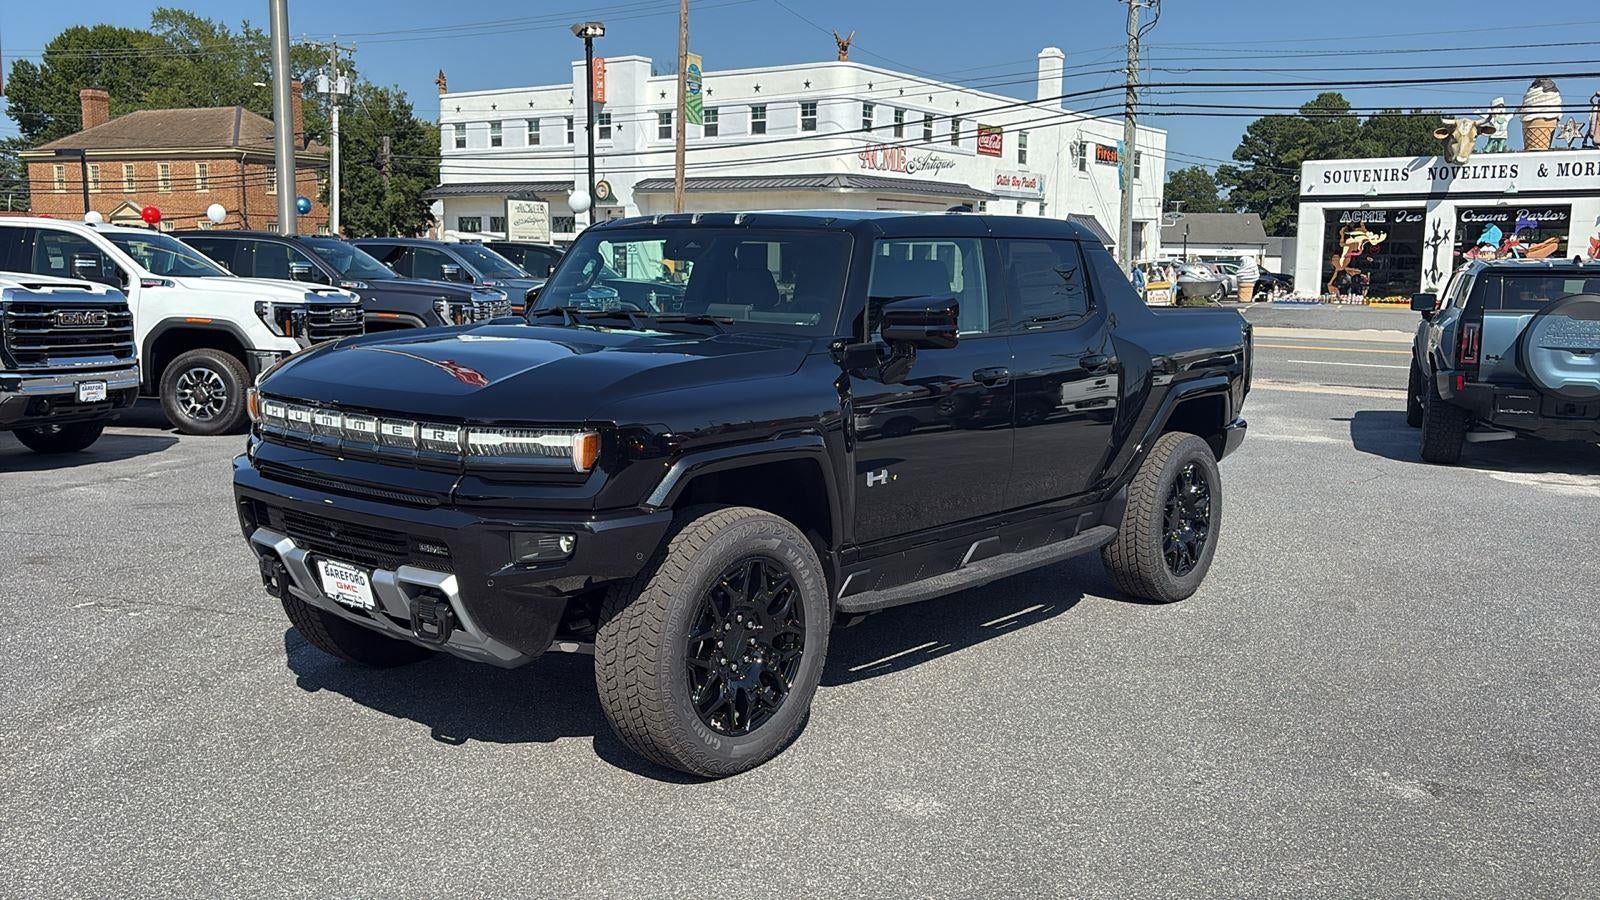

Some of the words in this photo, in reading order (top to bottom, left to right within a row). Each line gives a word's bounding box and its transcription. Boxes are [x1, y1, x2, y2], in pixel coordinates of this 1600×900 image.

[859, 143, 907, 173] ACME
[906, 152, 956, 176] Antiques
[1323, 166, 1410, 184] SOUVENIRS
[1427, 164, 1518, 181] NOVELTIES
[1537, 163, 1549, 178] &
[1556, 161, 1600, 177] MOR
[1339, 210, 1387, 223] ACME
[1395, 210, 1424, 222] Ice
[1460, 209, 1509, 222] Cream
[1516, 208, 1568, 222] Parlor
[627, 244, 637, 253] 25
[60, 311, 107, 325] GMC
[324, 566, 366, 586] BAREFORD
[336, 581, 359, 593] GMC
